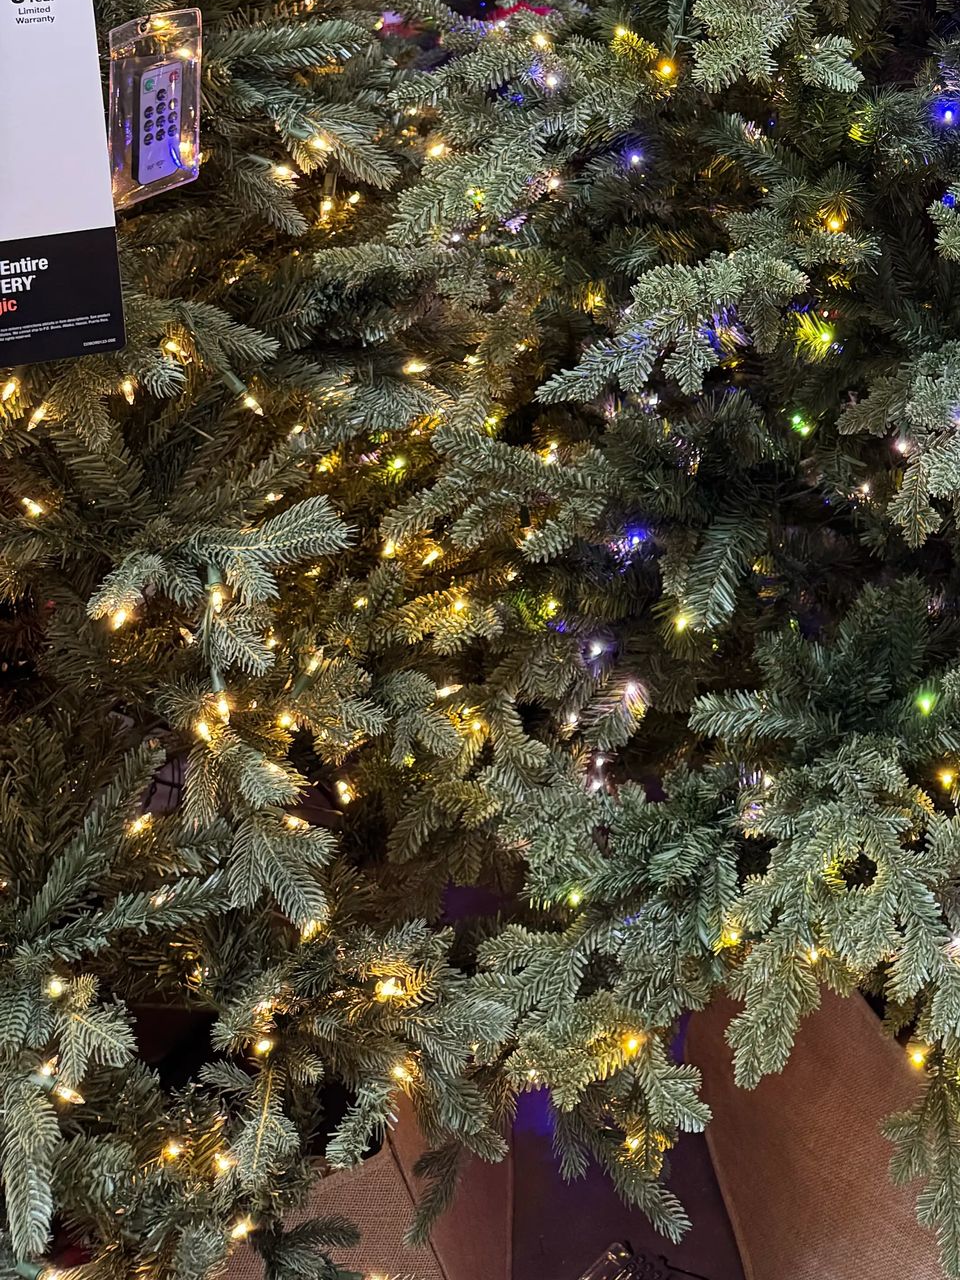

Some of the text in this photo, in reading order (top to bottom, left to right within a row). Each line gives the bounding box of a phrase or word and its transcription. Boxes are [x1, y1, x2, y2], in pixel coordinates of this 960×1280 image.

[18, 6, 51, 15] Limited
[15, 15, 55, 24] Warranty
[0, 257, 49, 276] Entire
